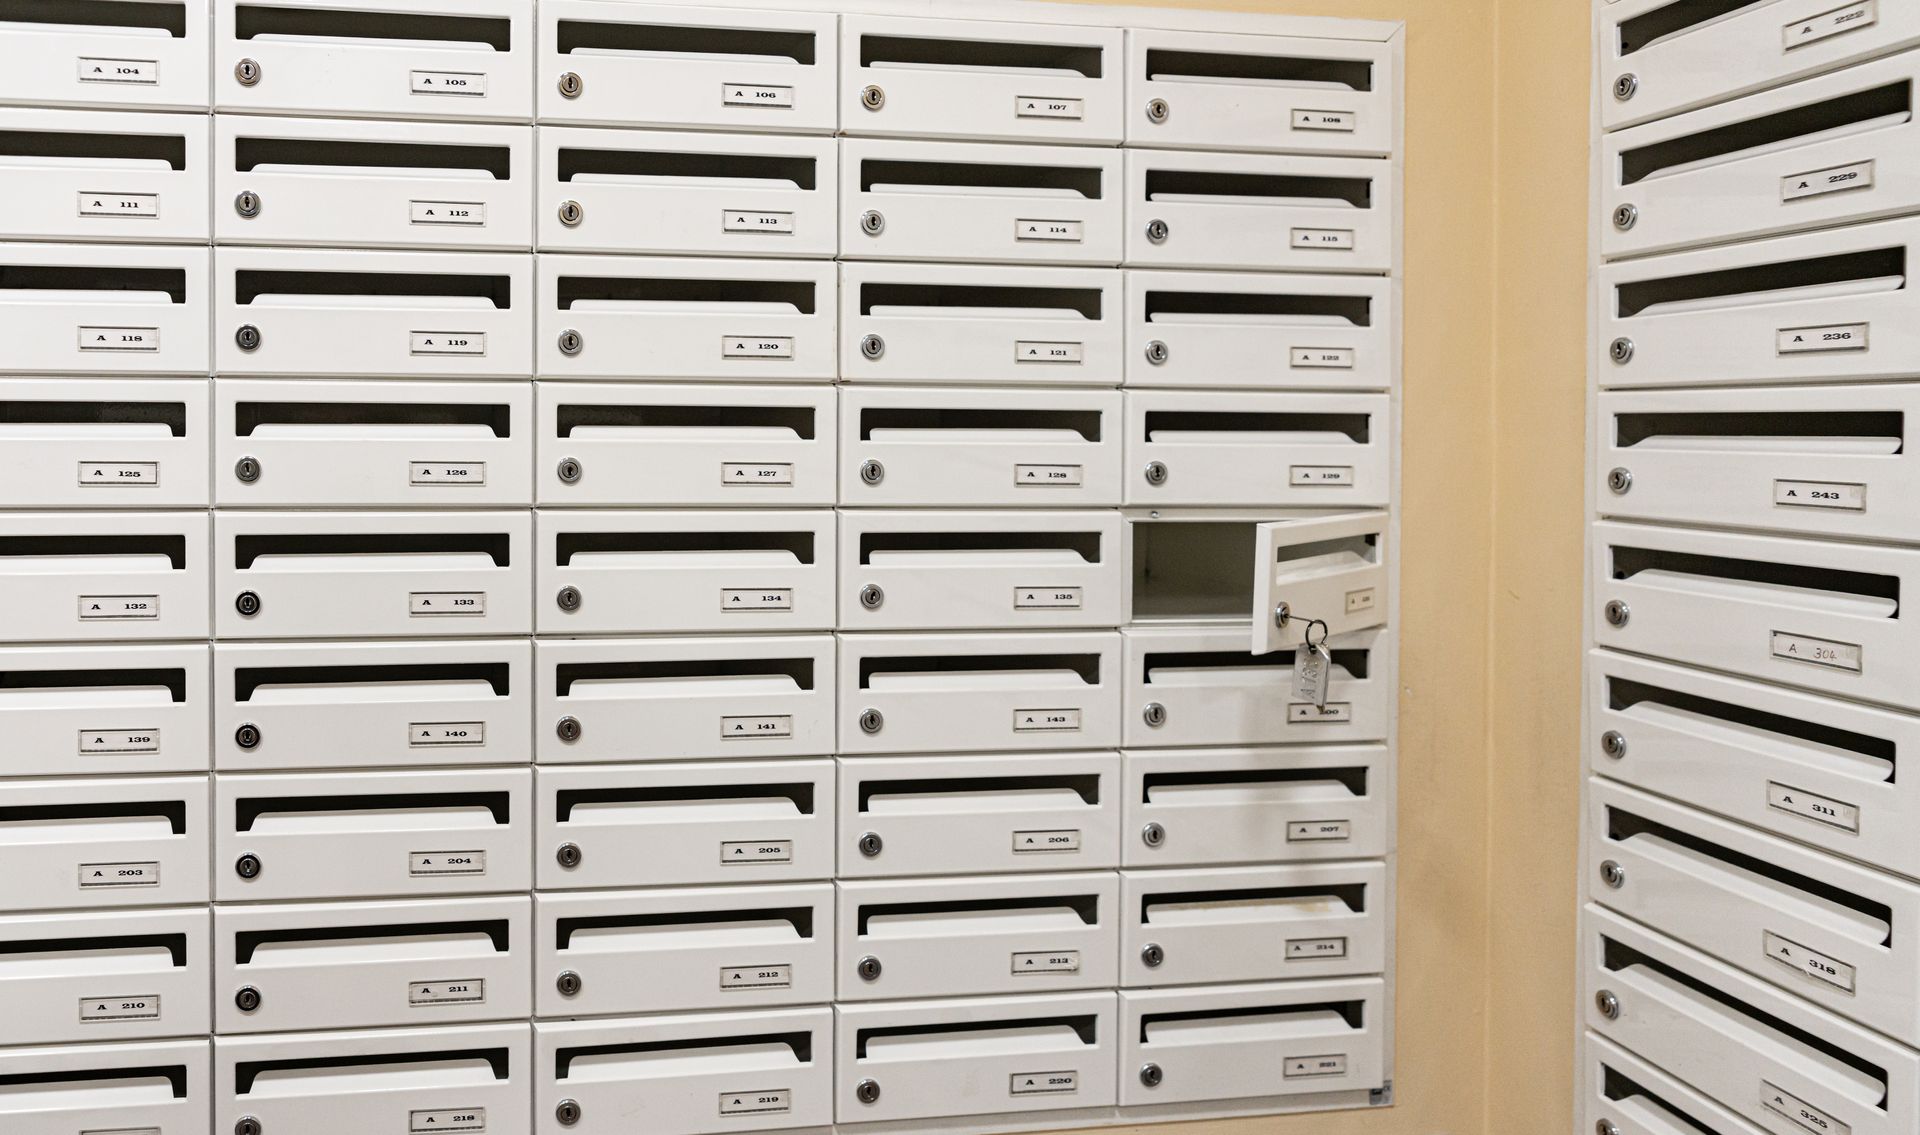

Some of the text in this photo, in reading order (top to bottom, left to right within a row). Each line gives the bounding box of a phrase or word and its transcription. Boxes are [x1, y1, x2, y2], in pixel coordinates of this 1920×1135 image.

[1800, 25, 1814, 35] A
[92, 66, 140, 75] A 104
[423, 77, 468, 87] A 105
[755, 91, 777, 99] 106
[1026, 102, 1068, 111] A 107
[1301, 115, 1311, 123] A
[1796, 171, 1859, 190] A 229
[92, 200, 140, 209] A 111
[424, 208, 470, 217] A 112
[736, 216, 778, 225] A 113
[1049, 226, 1068, 234] 114
[1301, 234, 1311, 242] A
[95, 334, 144, 343] A 118
[1792, 332, 1852, 343] A 236
[423, 338, 469, 347] A 119
[735, 342, 746, 350] A
[1028, 348, 1068, 357] A 121
[92, 469, 142, 478] A 125
[421, 468, 468, 477] A 126
[735, 469, 745, 477] A
[1047, 471, 1068, 479] 128
[1786, 489, 1841, 500] A 243
[731, 594, 783, 603] A 134
[1054, 593, 1074, 601] 135
[90, 602, 148, 611] A 132
[453, 598, 475, 606] 133
[1788, 642, 1798, 654] A
[1025, 716, 1035, 724] A
[756, 723, 777, 731] 141
[444, 730, 468, 738] 140
[93, 736, 151, 744] A 139
[1781, 795, 1837, 818] A 311
[1298, 826, 1308, 834] A
[1047, 836, 1070, 844] 206
[734, 846, 782, 855] A 205
[447, 857, 472, 865] 204
[92, 869, 144, 878] A 203
[1293, 943, 1302, 952] A
[1024, 957, 1069, 966] A 213
[1779, 946, 1837, 976] A 318
[732, 971, 779, 980] A 212
[420, 985, 469, 995] A 211
[96, 1001, 146, 1011] A 210
[1024, 1076, 1073, 1086] A 220
[757, 1096, 780, 1104] 219
[1773, 1095, 1829, 1130] A 325
[425, 1114, 476, 1124] A 218
